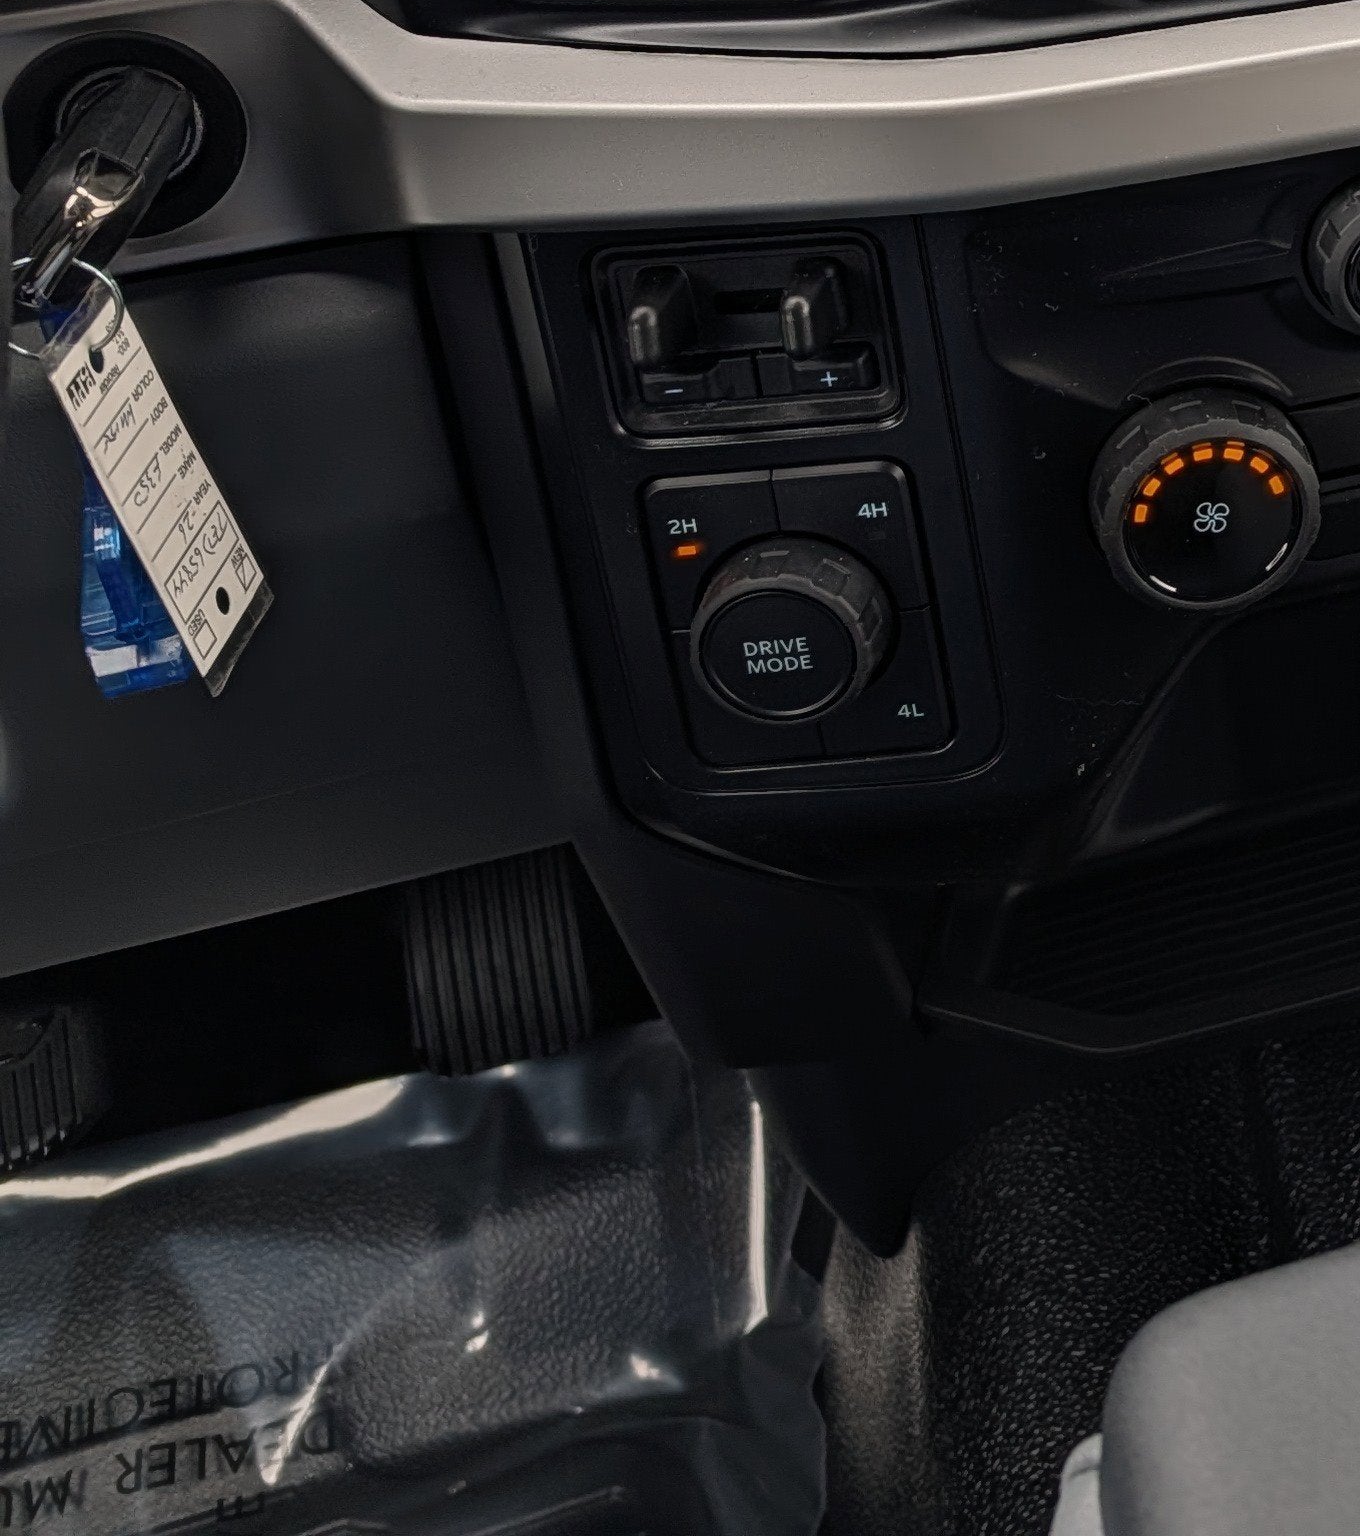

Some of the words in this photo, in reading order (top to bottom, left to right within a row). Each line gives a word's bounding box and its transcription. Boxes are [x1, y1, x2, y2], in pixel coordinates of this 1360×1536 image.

[132, 369, 155, 403] COLOR
[148, 396, 168, 425] BODY
[159, 423, 182, 458] MODEL
[176, 449, 197, 480] MAKE
[192, 477, 212, 508] YEAR
[858, 501, 888, 519] 4H
[668, 518, 698, 535] 2H
[230, 543, 246, 570] NEW
[187, 608, 207, 637] USED
[743, 636, 809, 657] DRIVE
[746, 654, 814, 675] MODE
[897, 703, 925, 719] 4L
[0, 1352, 330, 1464] ROTECTIV
